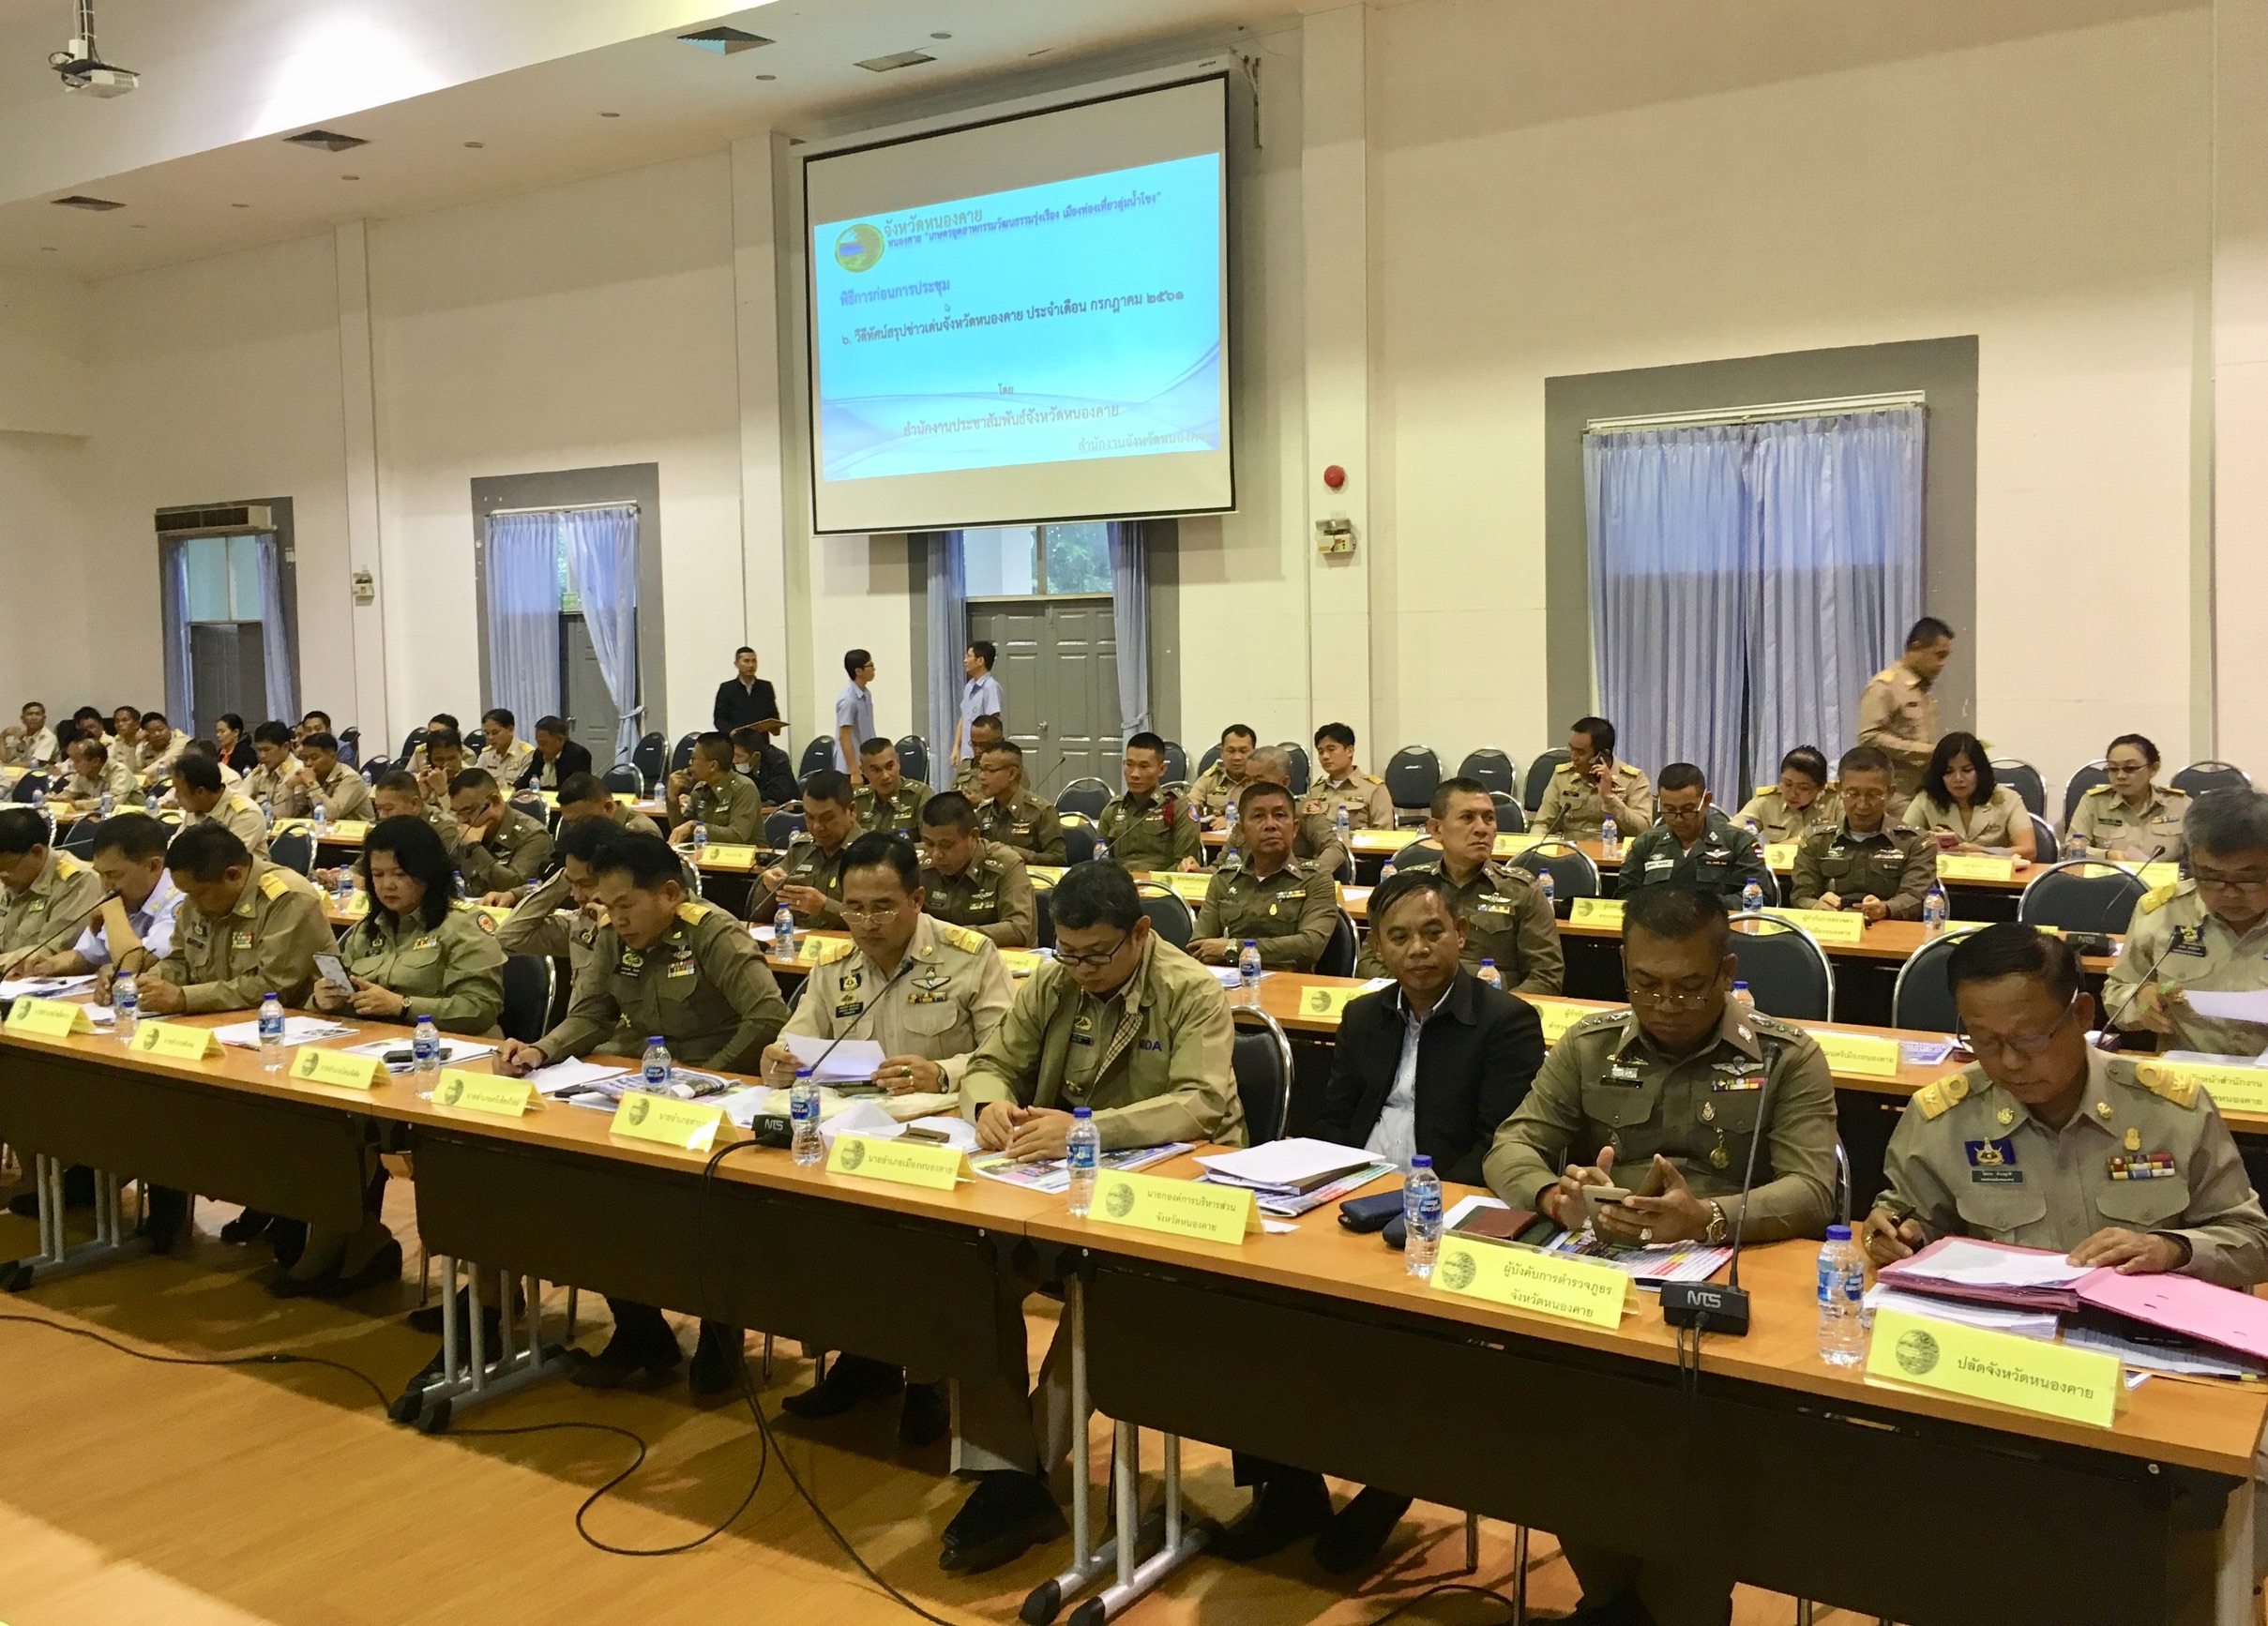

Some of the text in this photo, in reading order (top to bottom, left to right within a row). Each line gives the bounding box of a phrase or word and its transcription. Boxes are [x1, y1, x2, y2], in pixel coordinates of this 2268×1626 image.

[884, 208, 983, 238] จังหวัดหนองคาย
[839, 279, 950, 307] พิธีการก่อนการประชุม
[1026, 298, 1087, 320] ประจำเดือน
[1090, 293, 1142, 313] กรกฎาคม
[998, 383, 1014, 396] โดย
[903, 403, 1120, 437] สำนักงานประชาสัมพันธ์จังหวัดหนองคาย
[868, 1153, 954, 1175] นายอำเภอเมืองหนองคาย
[1146, 1188, 1237, 1212] นายกองค์การบริหารส่วน
[1155, 1212, 1217, 1232] จังหวัดหนองคาย
[1503, 1260, 1613, 1297] ผู้บังคับการตำรวจภูธร
[1509, 1287, 1595, 1318] จังหวัดหนองคาย
[1957, 1355, 2094, 1400] ปลัดจังหวัดหนองคาย
